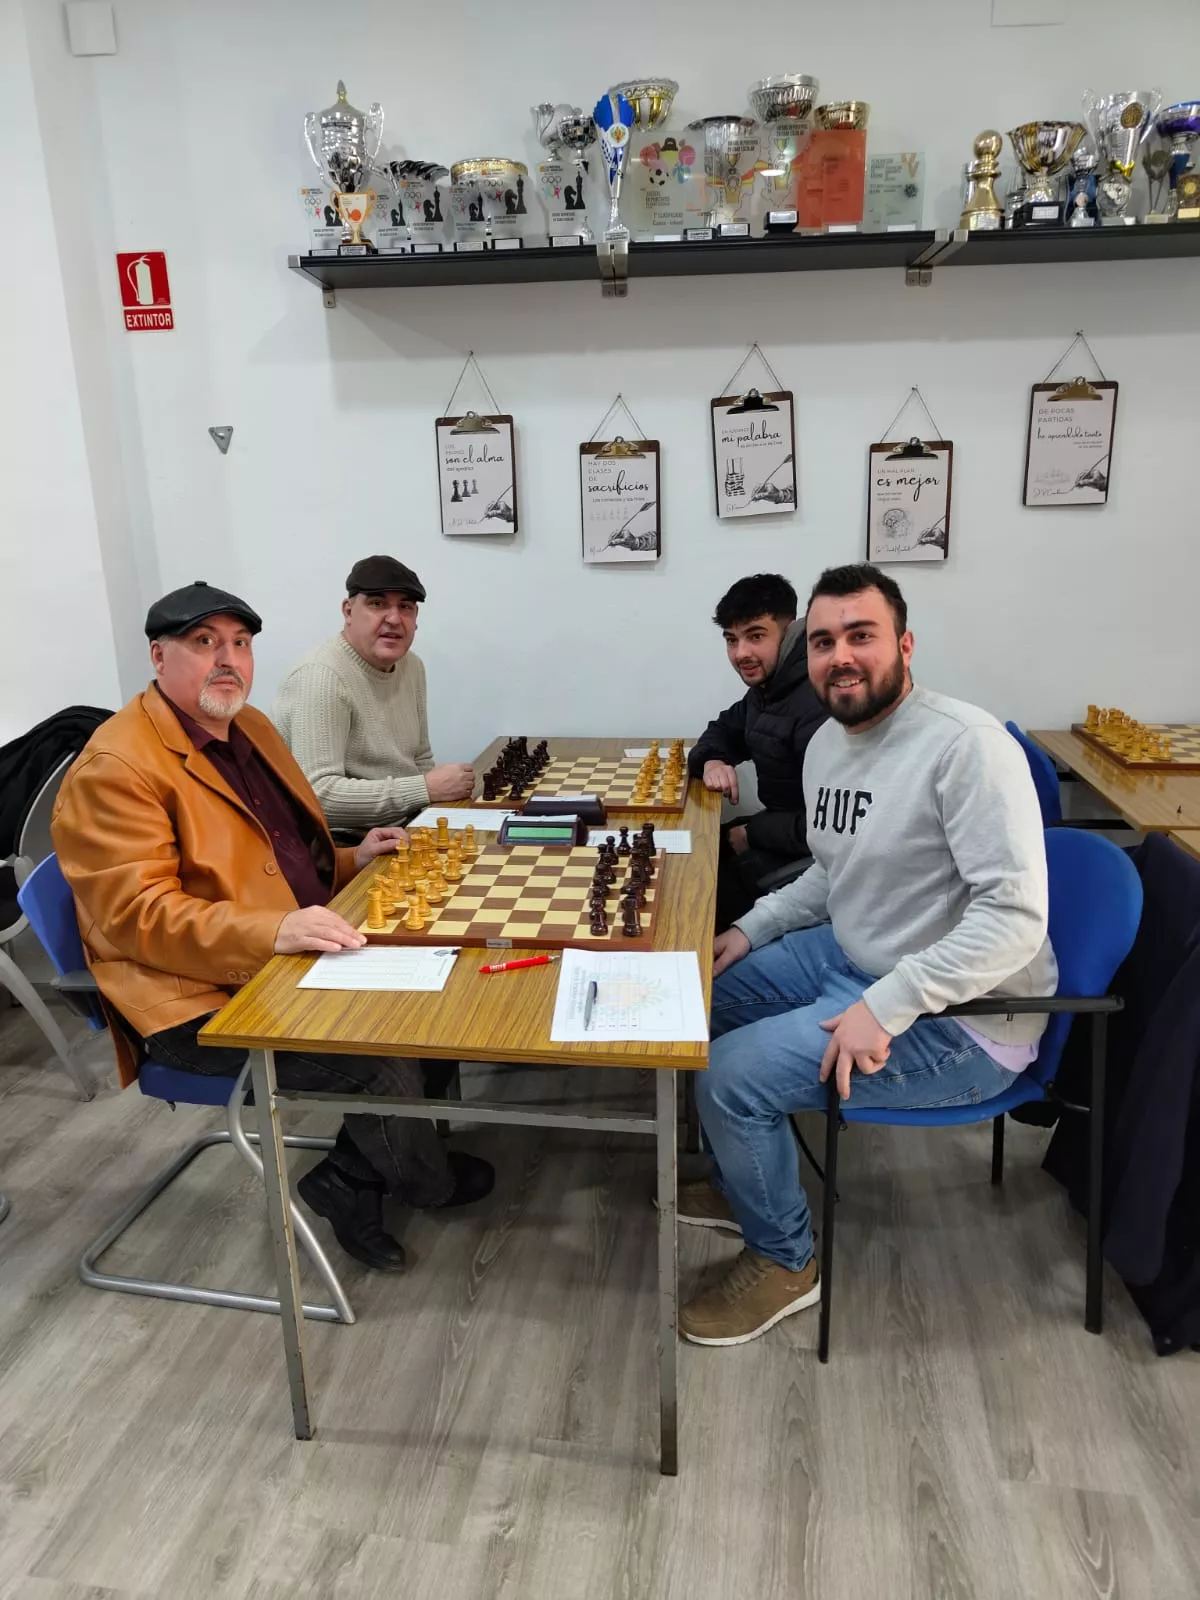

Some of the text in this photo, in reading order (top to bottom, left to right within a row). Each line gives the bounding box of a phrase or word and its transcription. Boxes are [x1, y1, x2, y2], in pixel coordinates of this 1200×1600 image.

[126, 313, 172, 327] EXTINTOR
[737, 419, 781, 448] palabra
[476, 442, 504, 463] alma
[587, 469, 649, 496] sacrificios
[876, 473, 940, 502] es mejor
[813, 786, 873, 836] HUF
